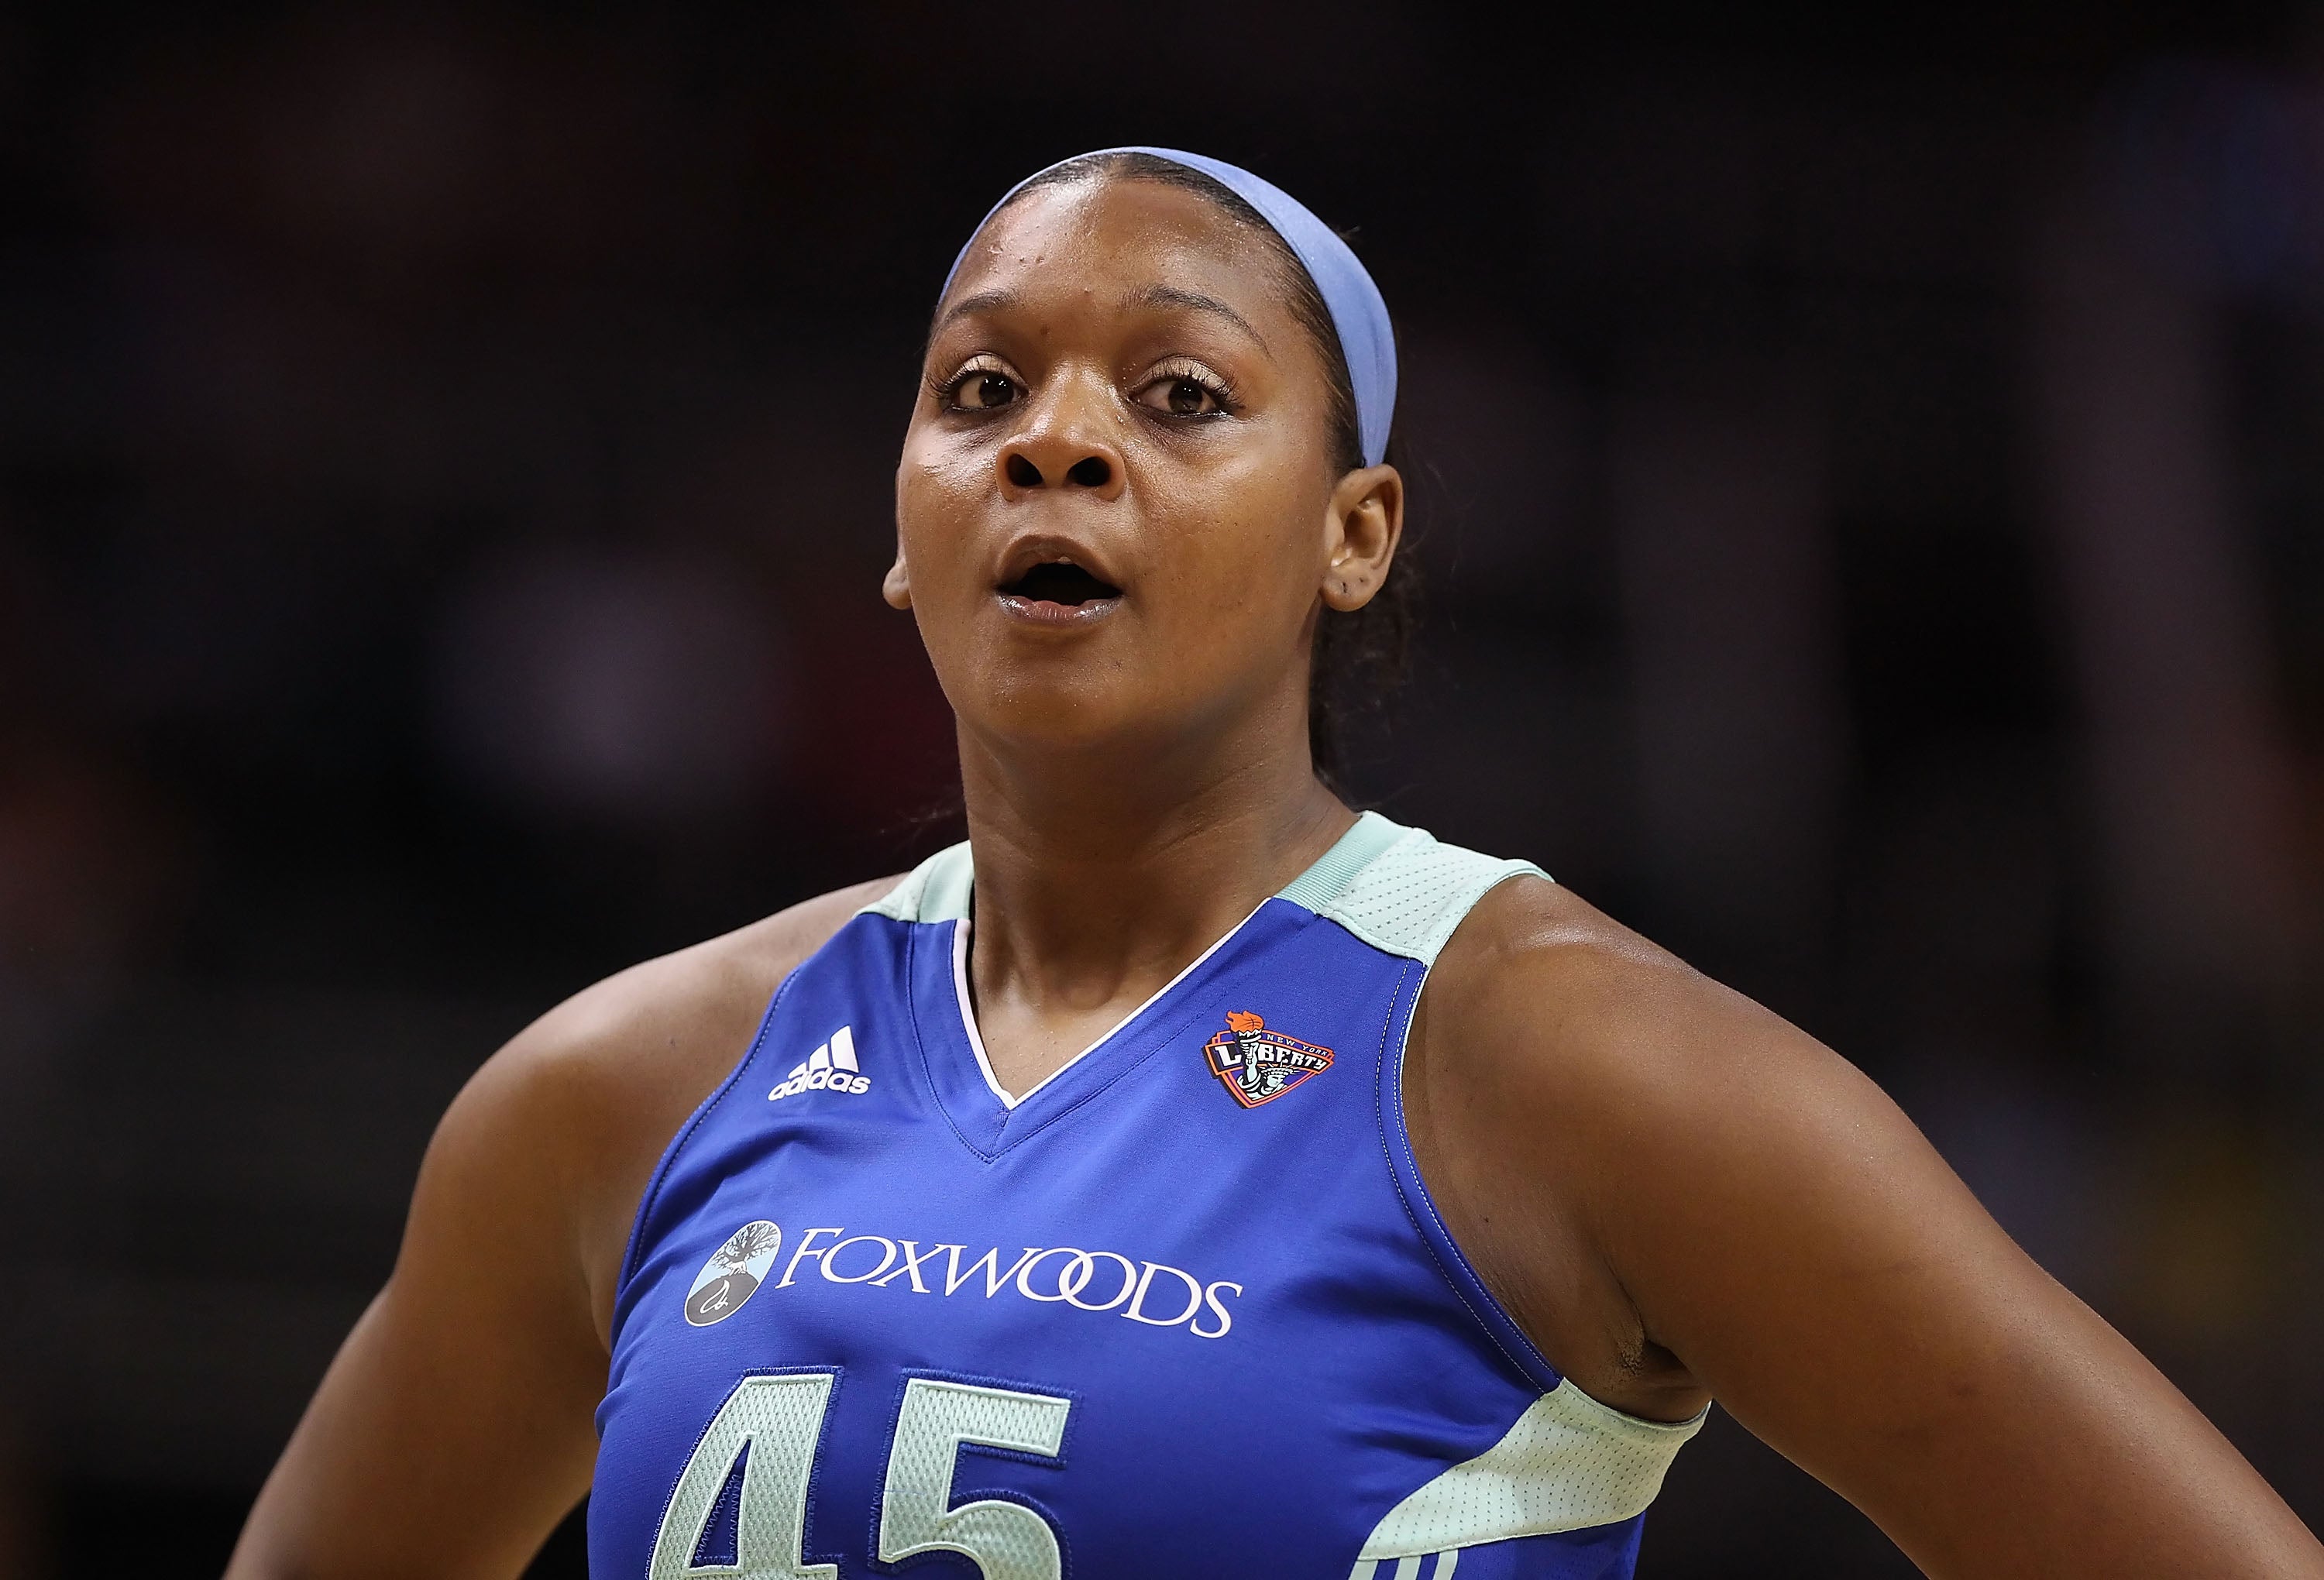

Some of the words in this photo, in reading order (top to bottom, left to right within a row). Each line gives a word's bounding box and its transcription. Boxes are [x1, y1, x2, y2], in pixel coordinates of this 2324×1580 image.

[1267, 1034, 1296, 1046] NEW
[1302, 1046, 1328, 1056] YORK
[768, 1066, 871, 1101] adidas
[775, 1227, 1243, 1339] FOXWOODS
[648, 1372, 1072, 1580] 45
